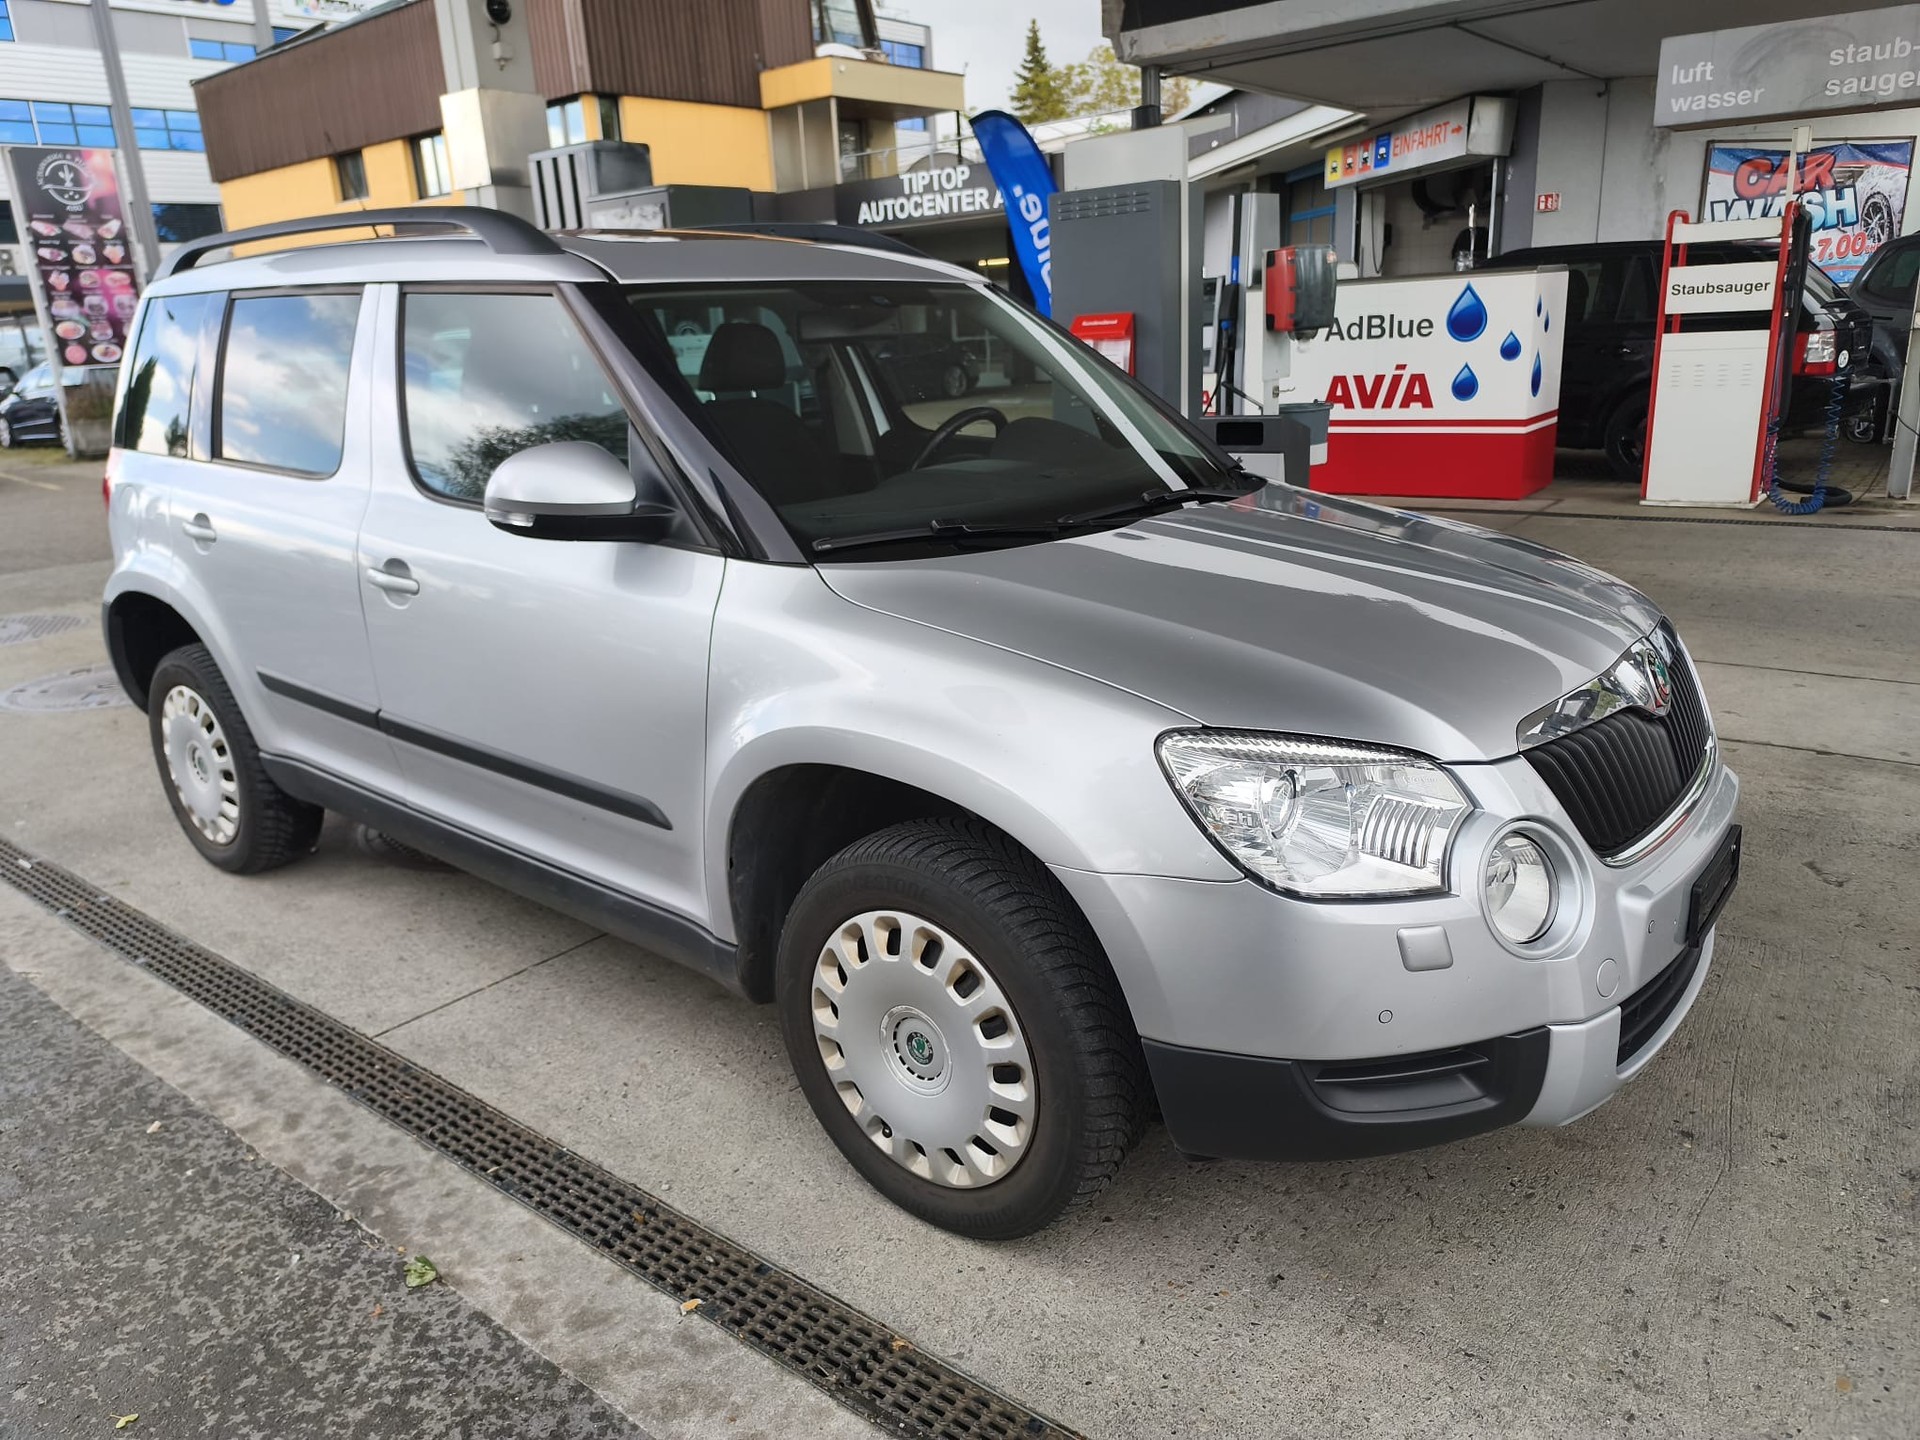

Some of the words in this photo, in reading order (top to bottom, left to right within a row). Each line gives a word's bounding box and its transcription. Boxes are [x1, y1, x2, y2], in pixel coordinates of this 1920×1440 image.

[1829, 36, 1920, 66] staub-
[1671, 61, 1715, 85] luft
[1670, 86, 1766, 112] wasser
[1392, 121, 1451, 158] EINFAHRT
[900, 165, 971, 195] TIPTOP
[1734, 153, 1836, 200] CAR
[858, 188, 989, 225] AUTOCENTER
[1817, 231, 1867, 262] 7.00
[1671, 281, 1770, 296] Staubsauger
[1325, 314, 1434, 342] AdBlue
[1208, 805, 1253, 826] Yeti
